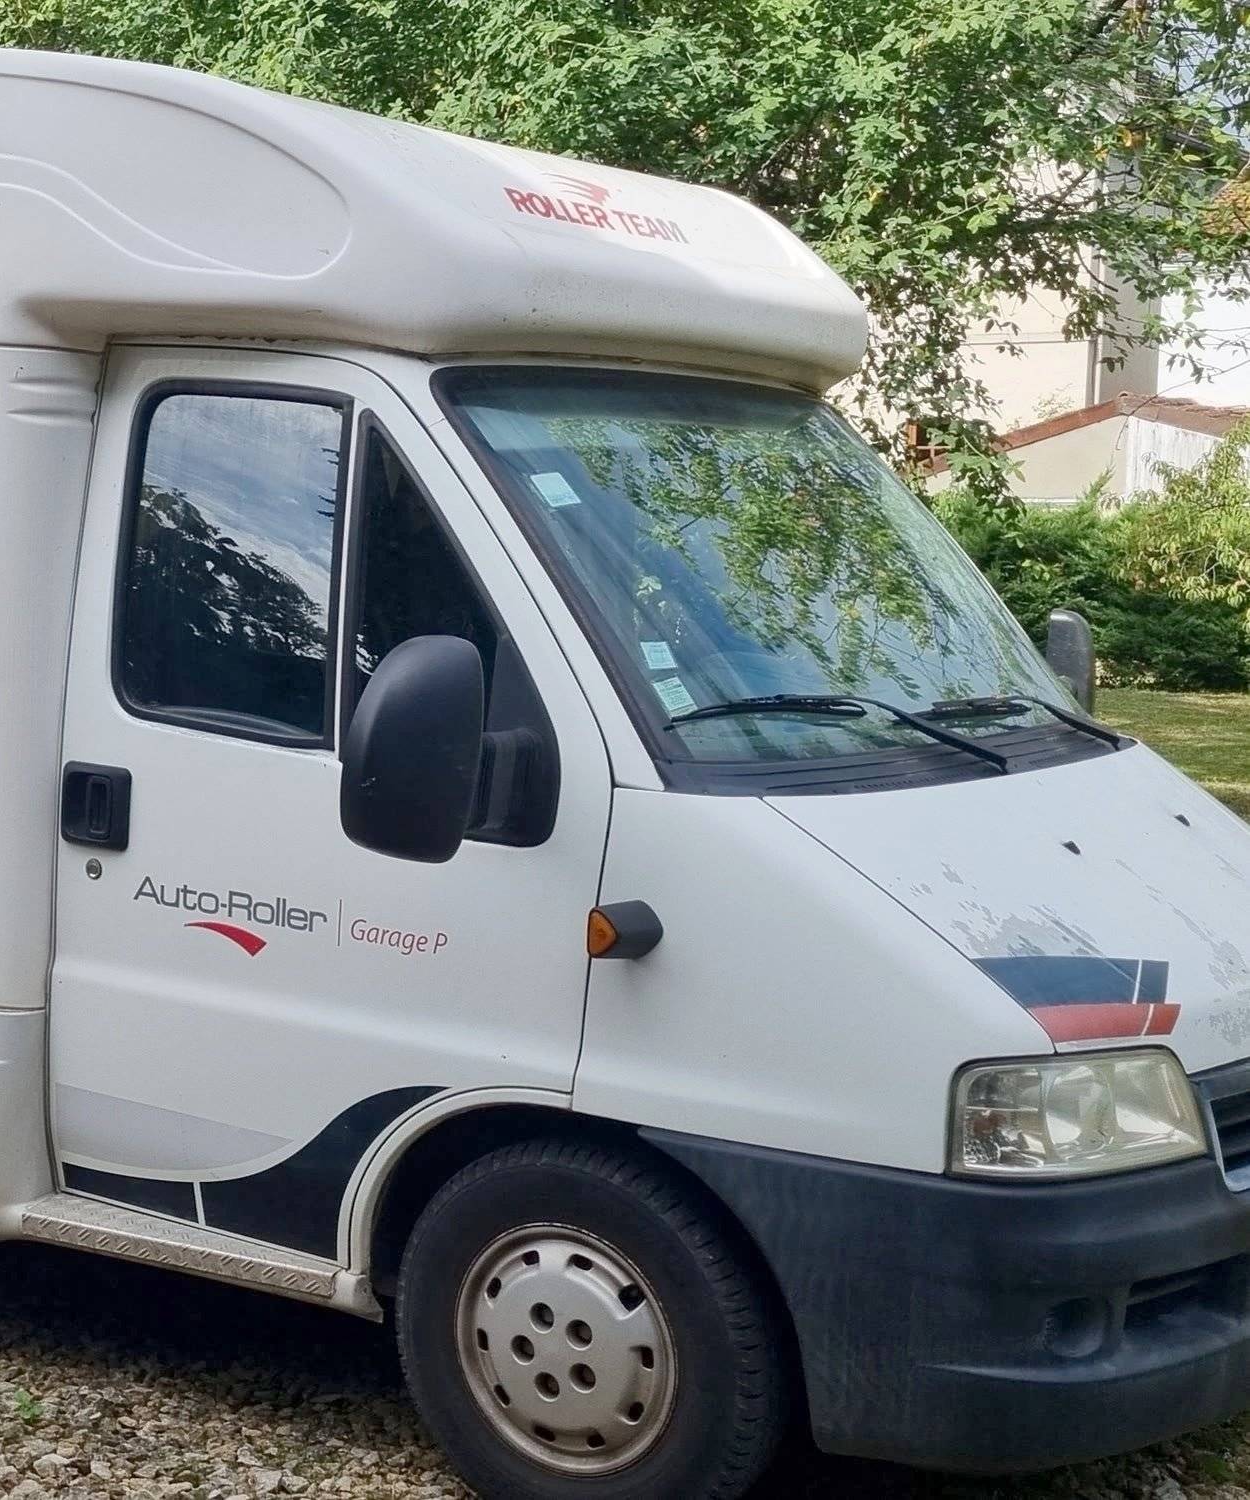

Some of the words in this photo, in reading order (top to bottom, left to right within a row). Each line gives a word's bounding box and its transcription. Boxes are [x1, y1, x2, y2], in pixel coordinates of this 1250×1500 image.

[503, 187, 615, 230] ROLLER
[610, 210, 690, 244] TEAM
[133, 876, 327, 932] Auto-Roller
[350, 919, 428, 955] Garage
[432, 932, 448, 954] P
